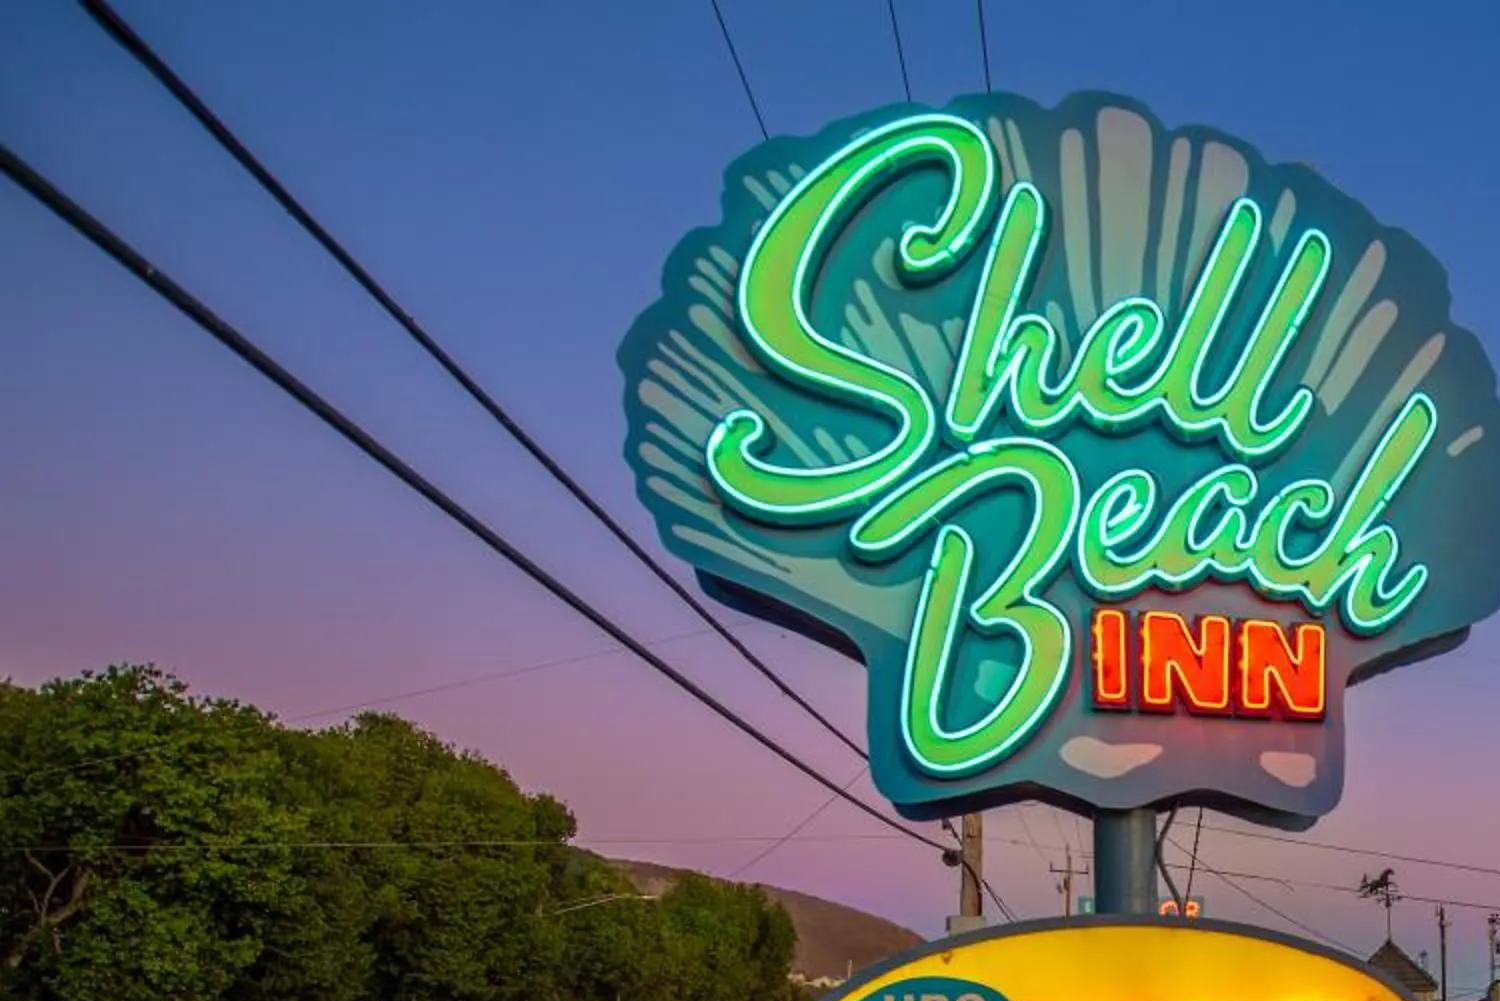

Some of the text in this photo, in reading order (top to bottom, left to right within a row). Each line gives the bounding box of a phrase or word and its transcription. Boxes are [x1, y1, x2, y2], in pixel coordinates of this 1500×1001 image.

[707, 112, 1332, 515] Shell
[850, 393, 1438, 778] Beach
[1092, 608, 1327, 718] INN
